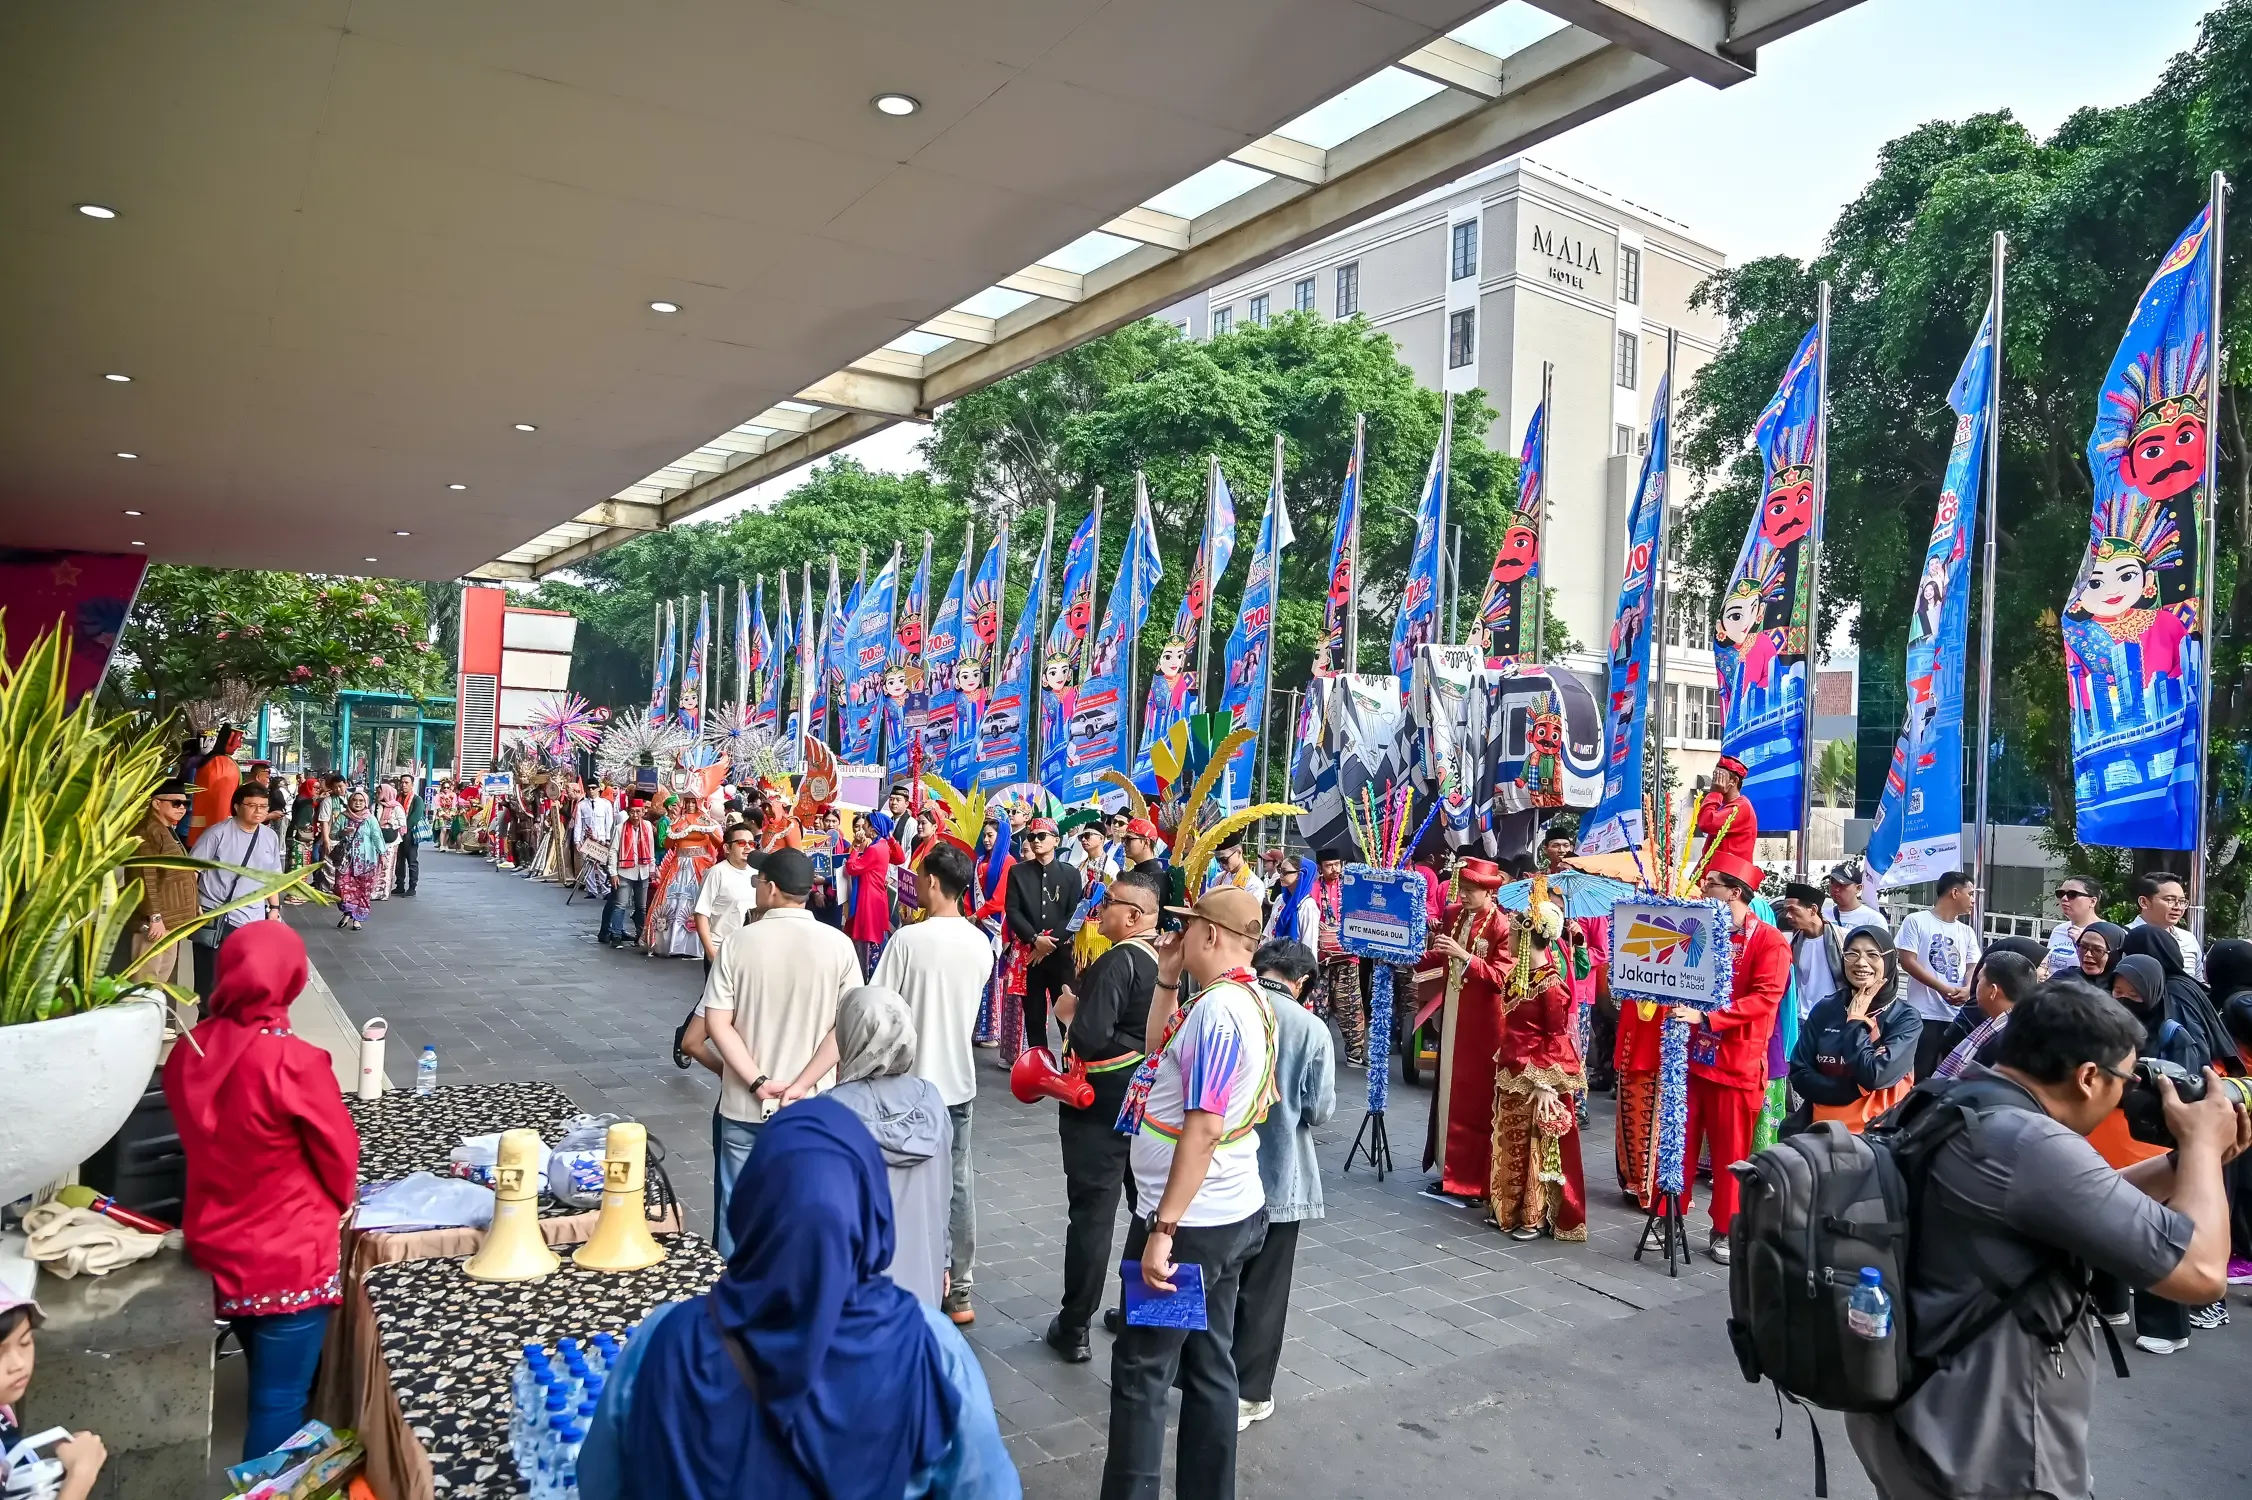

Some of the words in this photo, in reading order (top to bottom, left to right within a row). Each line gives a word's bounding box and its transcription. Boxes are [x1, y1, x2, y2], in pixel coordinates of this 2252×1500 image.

[1533, 225, 1602, 275] MAIA
[1549, 266, 1584, 289] HOTEL
[942, 638, 956, 646] OFF
[874, 648, 885, 659] OFF
[1445, 651, 1473, 672] hello
[1349, 925, 1362, 933] WTC
[1363, 927, 1389, 938] MANGGA
[1619, 964, 1676, 987] Jakarta
[1680, 972, 1705, 984] Menuju
[1685, 982, 1704, 990] Abad
